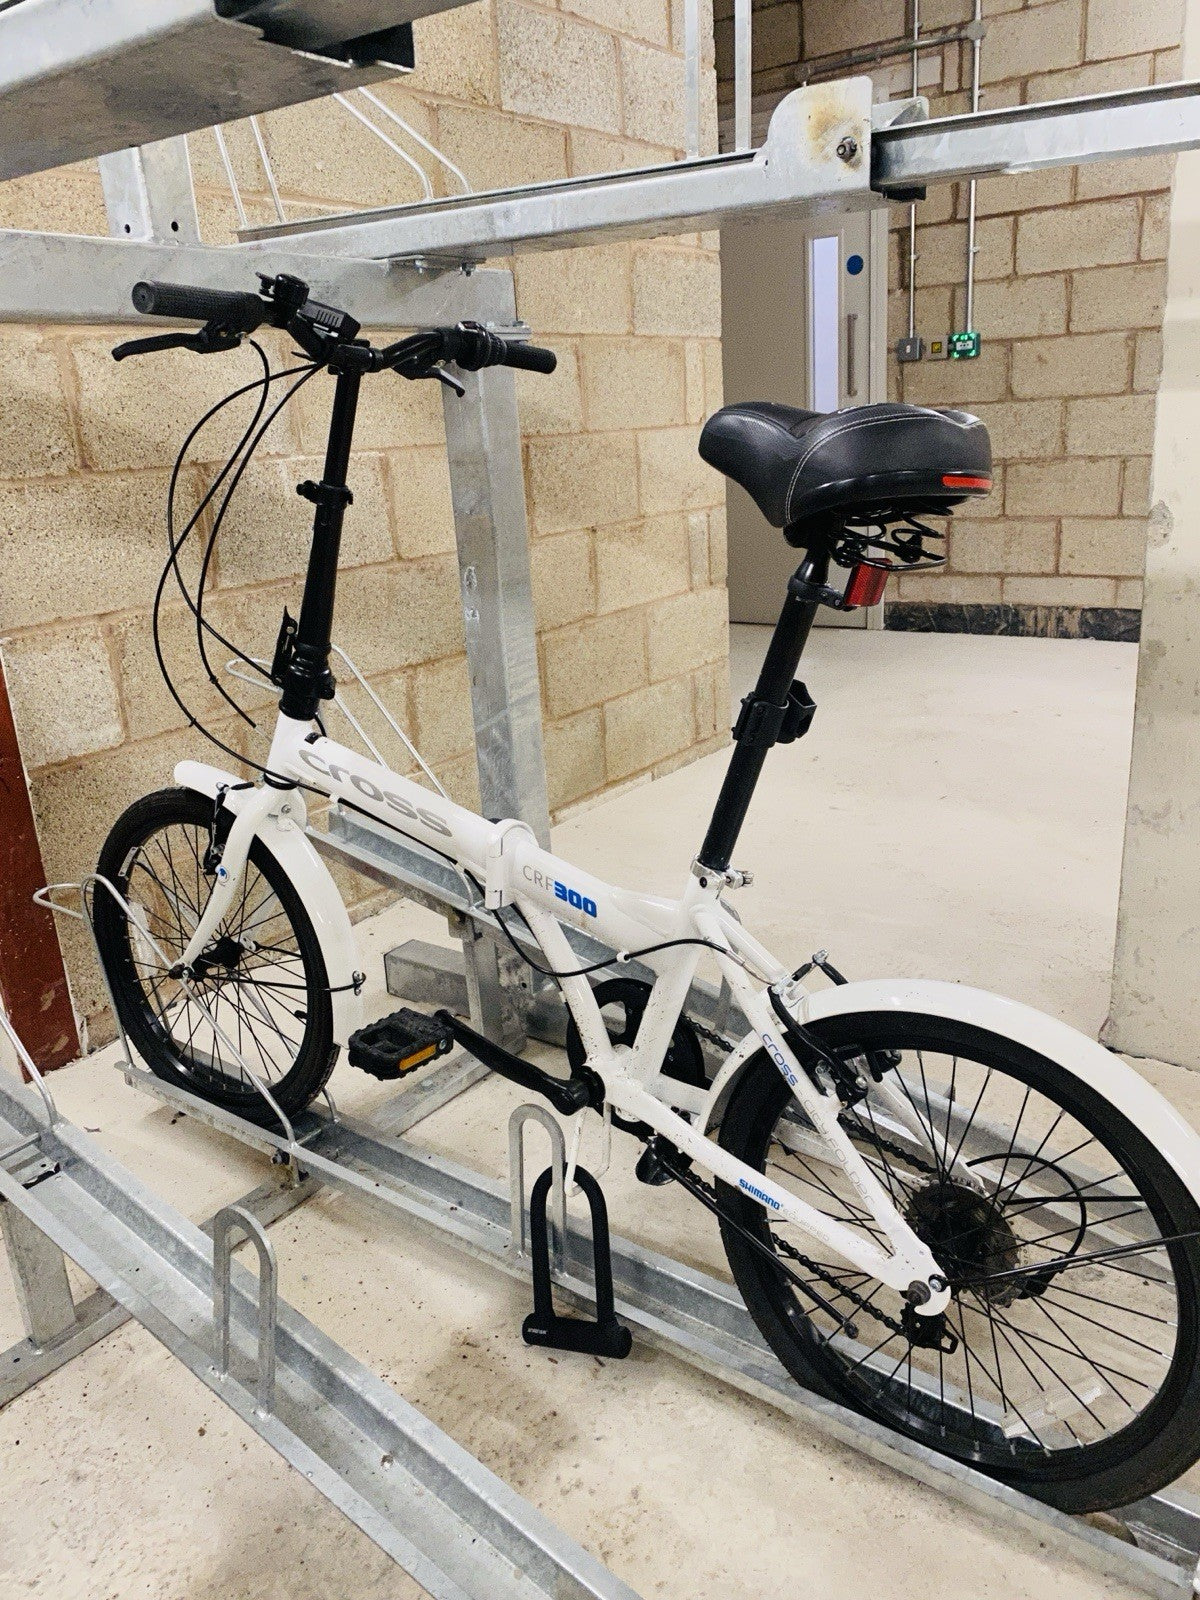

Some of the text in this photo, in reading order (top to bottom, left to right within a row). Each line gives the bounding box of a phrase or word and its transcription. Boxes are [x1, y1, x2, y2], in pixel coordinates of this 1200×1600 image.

[298, 749, 453, 838] cross
[522, 865, 598, 918] CRF300
[761, 1033, 799, 1087] cross
[738, 1178, 781, 1211] SHIMANO
